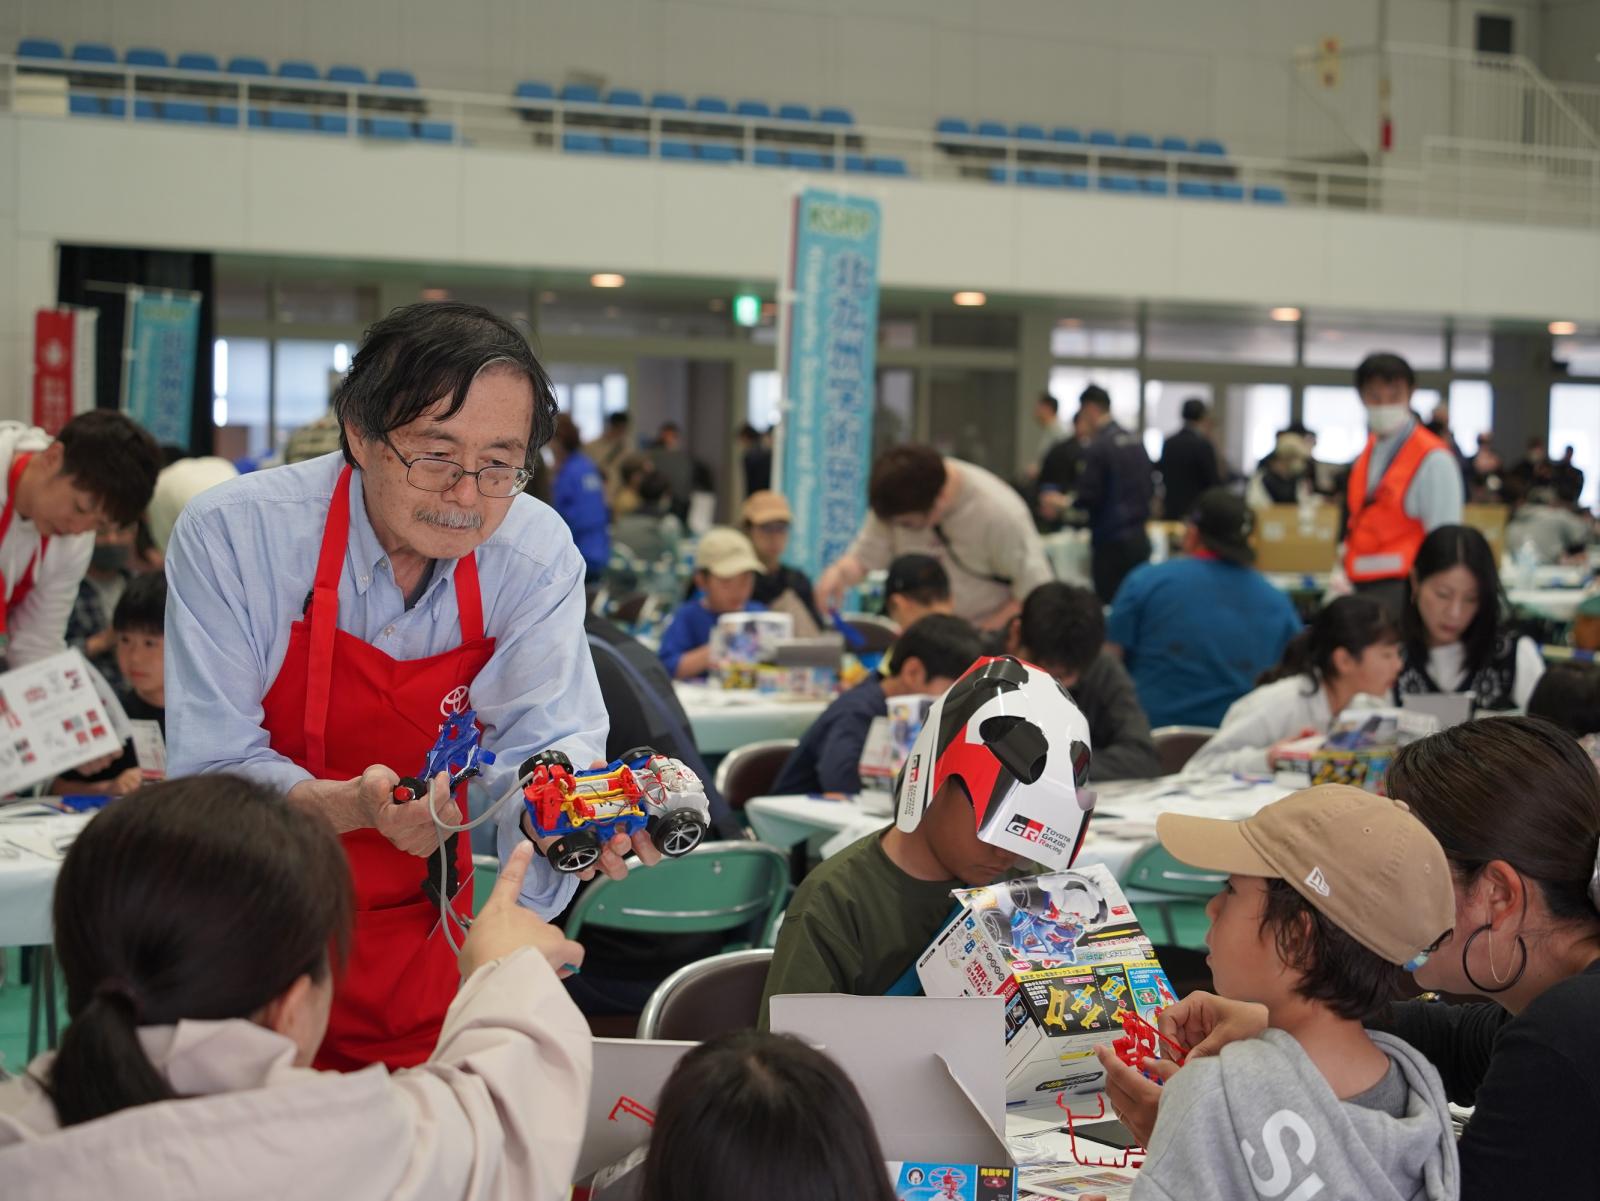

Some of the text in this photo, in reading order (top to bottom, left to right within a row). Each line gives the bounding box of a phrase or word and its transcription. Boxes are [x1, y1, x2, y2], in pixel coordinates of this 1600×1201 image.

[1006, 819, 1042, 842] GR
[1046, 827, 1071, 843] TOYOTA
[1038, 839, 1063, 855] Racing
[1041, 833, 1067, 849] GAZOO
